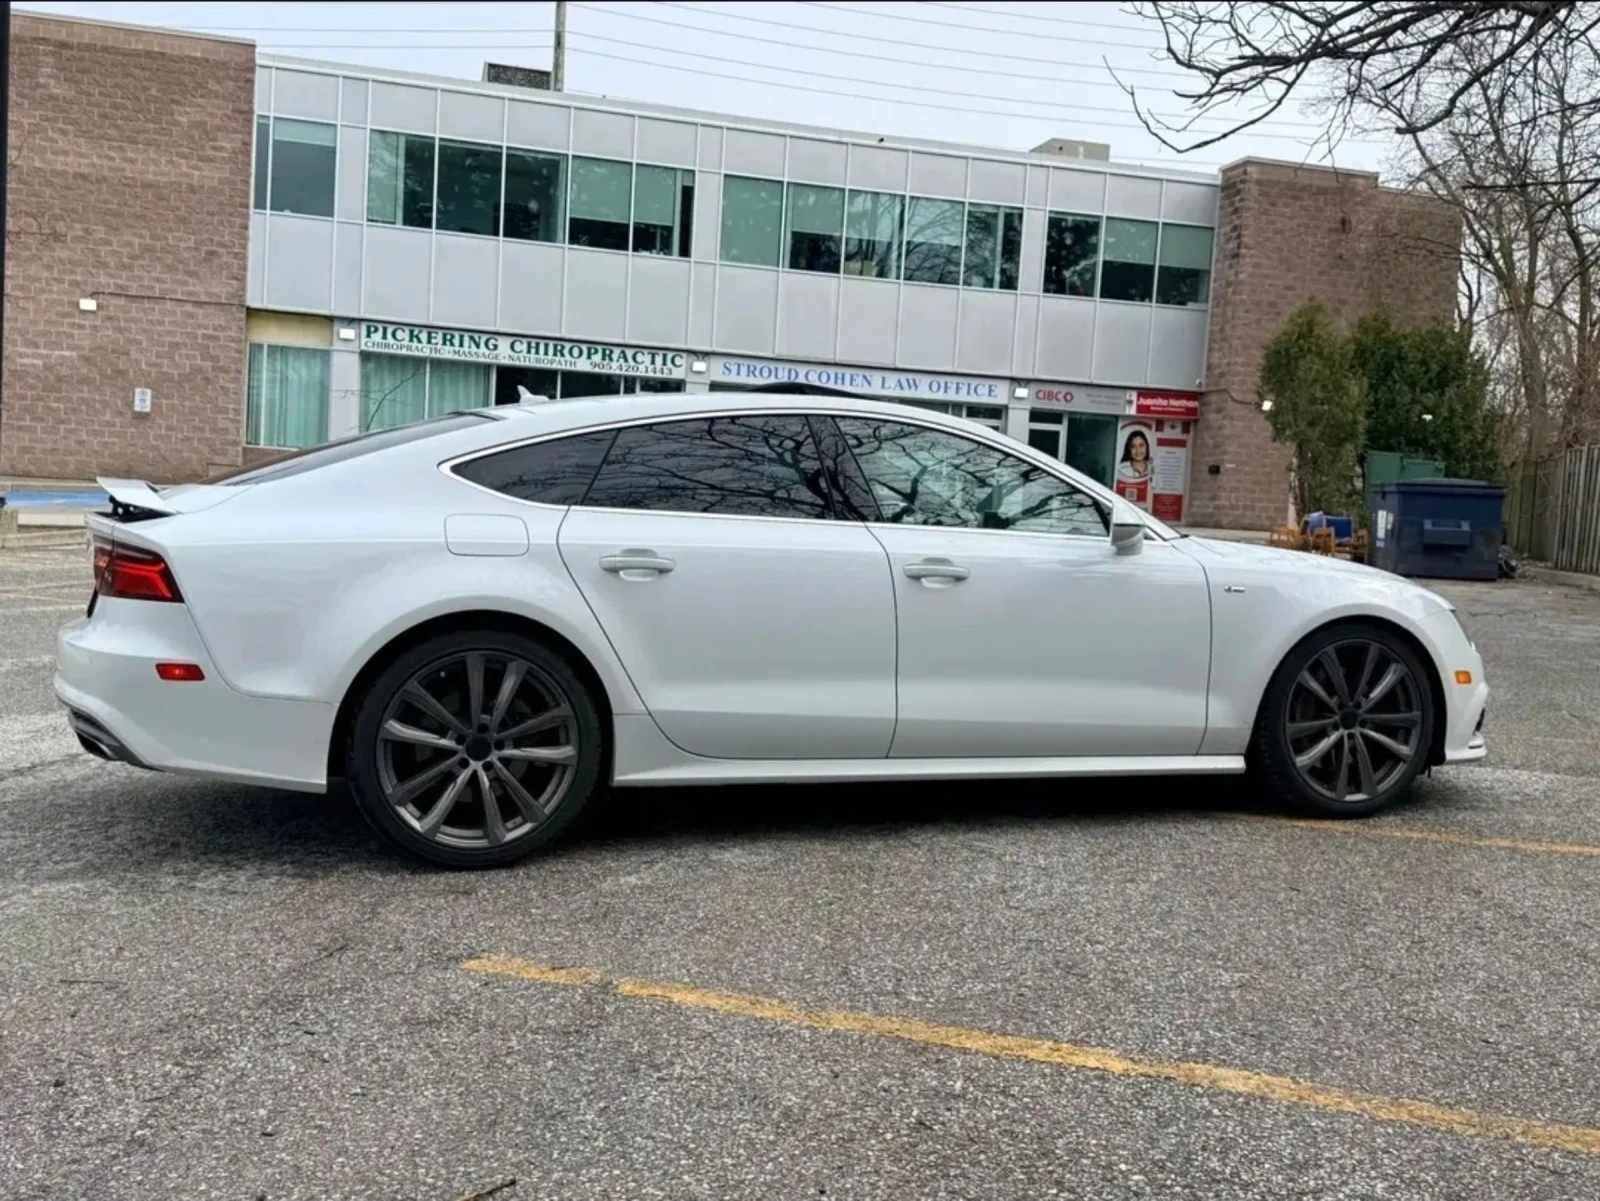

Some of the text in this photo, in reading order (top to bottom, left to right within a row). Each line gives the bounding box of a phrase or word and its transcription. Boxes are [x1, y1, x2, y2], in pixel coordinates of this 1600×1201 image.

[364, 340, 673, 376] CHIROPRACTIC MASSAGE NATUROPATH 905.420.1443
[365, 324, 684, 368] PICKERING CHIROPRACTIC
[722, 361, 998, 398] STROUD COHEN LAW OFFICE
[1035, 389, 1061, 402] CIBC
